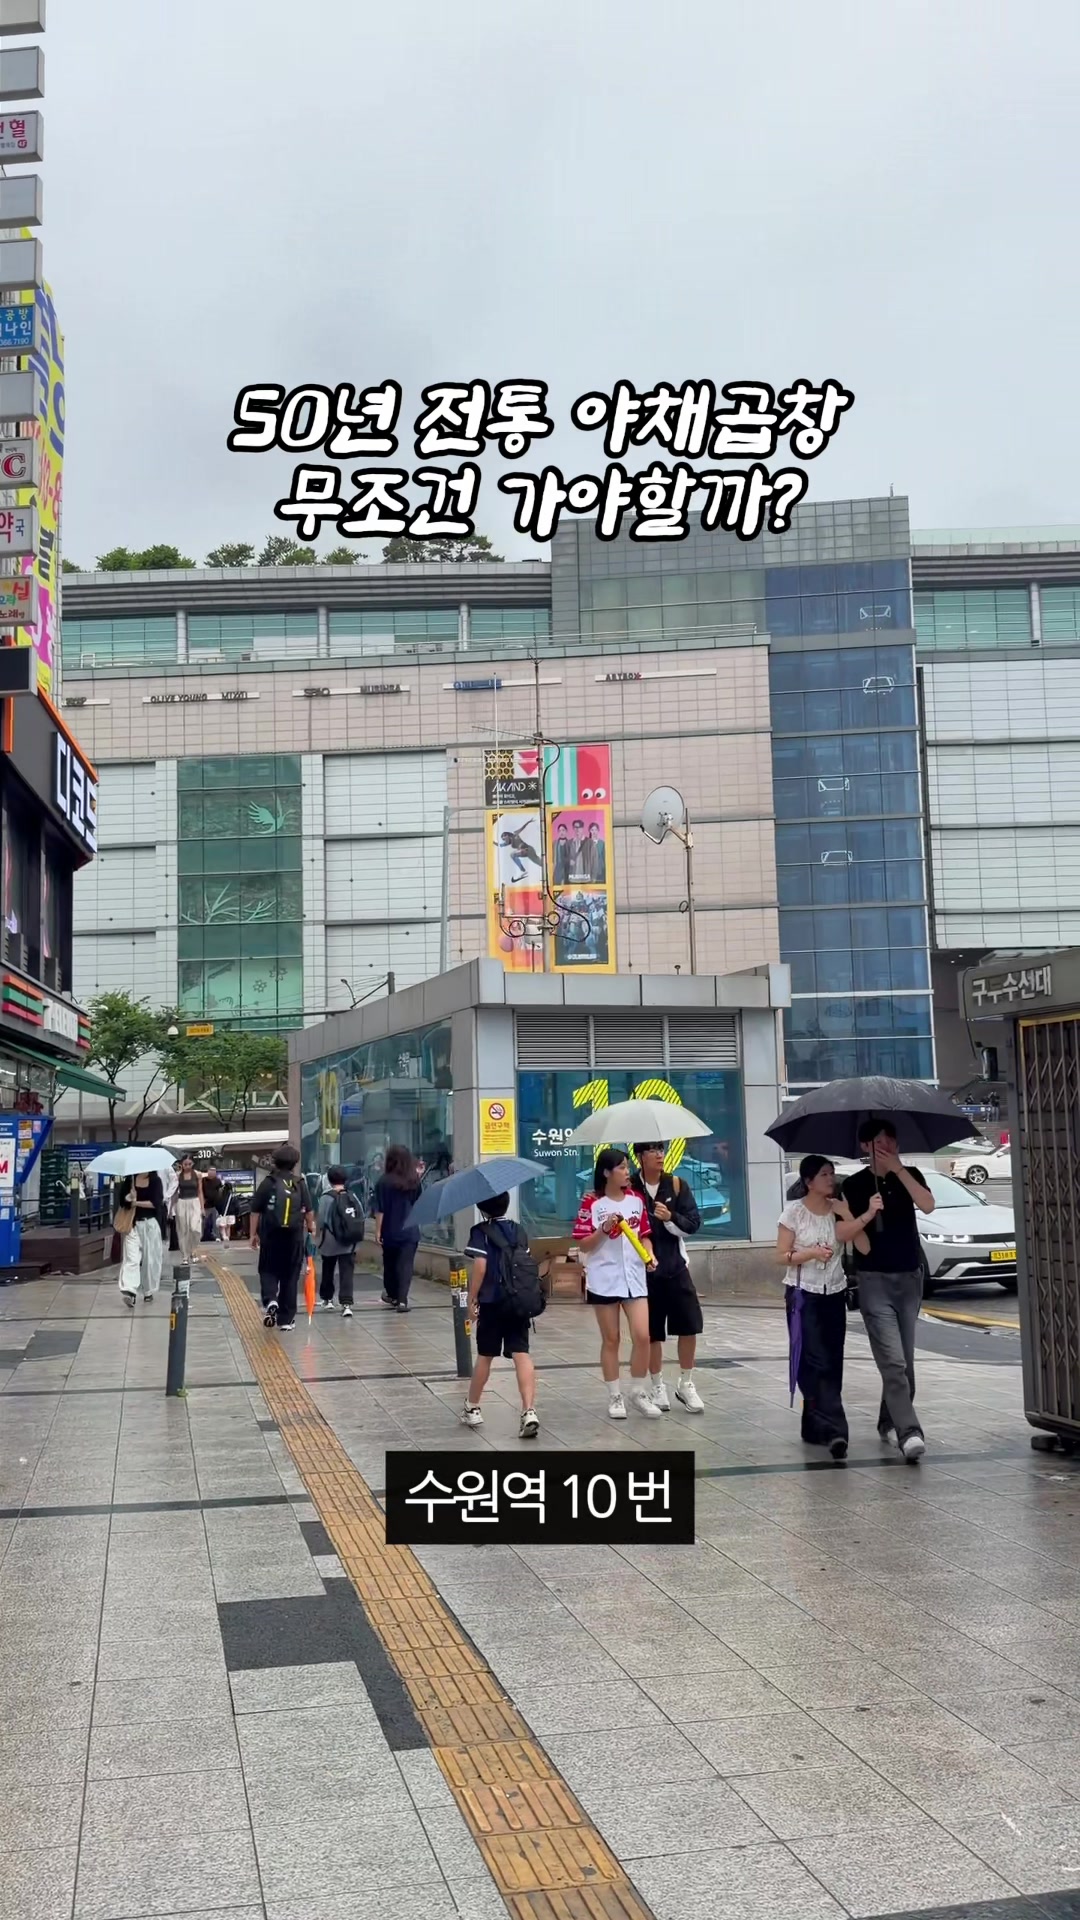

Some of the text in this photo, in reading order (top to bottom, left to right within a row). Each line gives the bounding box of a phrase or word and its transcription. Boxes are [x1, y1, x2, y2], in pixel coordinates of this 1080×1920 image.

[0, 119, 25, 139] 혈
[0, 308, 28, 321] 공방
[0, 320, 32, 337] 나인
[0, 453, 26, 479] C
[150, 692, 208, 704] OLIVE YOUNG
[533, 1148, 580, 1157] Suwon Stn.
